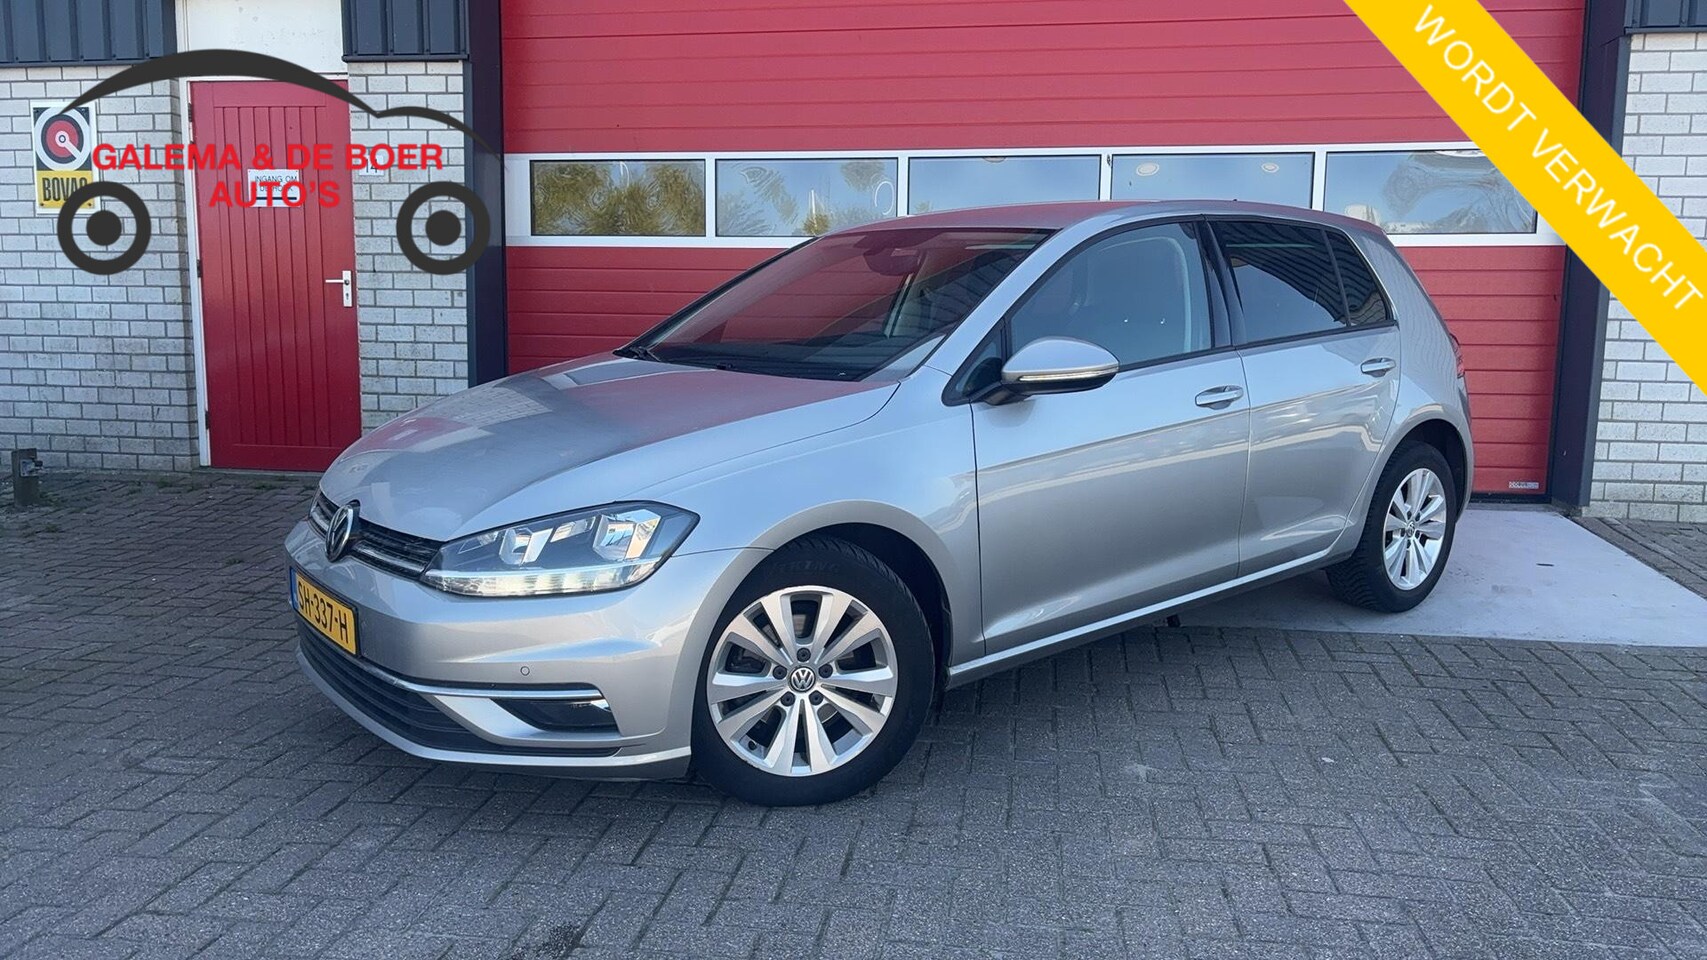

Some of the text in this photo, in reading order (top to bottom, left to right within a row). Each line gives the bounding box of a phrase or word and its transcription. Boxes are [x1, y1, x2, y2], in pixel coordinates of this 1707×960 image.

[41, 176, 88, 202] BOVA
[254, 175, 298, 184] INGANG OM
[297, 580, 349, 645] SH-337-H
